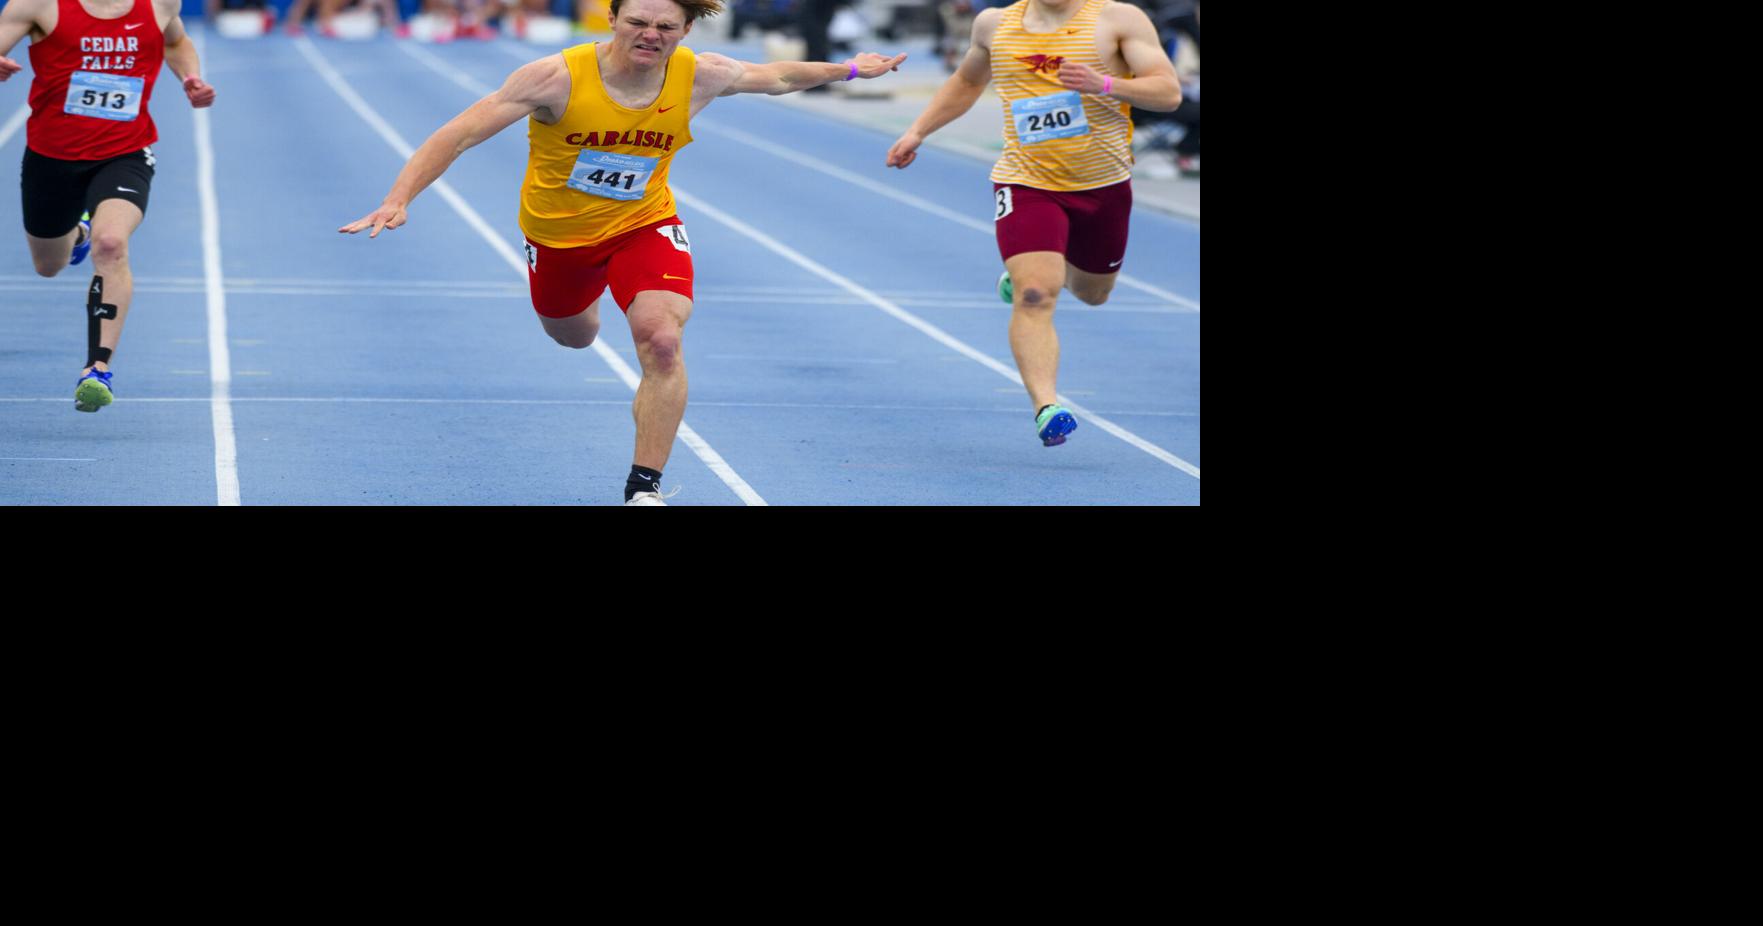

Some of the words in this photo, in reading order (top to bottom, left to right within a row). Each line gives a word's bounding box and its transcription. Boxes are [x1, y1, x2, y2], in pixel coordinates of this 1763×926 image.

[81, 36, 138, 52] CEDAR
[81, 55, 136, 70] FALLS
[82, 89, 126, 110] 513
[1028, 111, 1071, 131] 240
[565, 129, 674, 152] CARLISLE
[587, 169, 635, 190] 441
[998, 190, 1006, 217] 3
